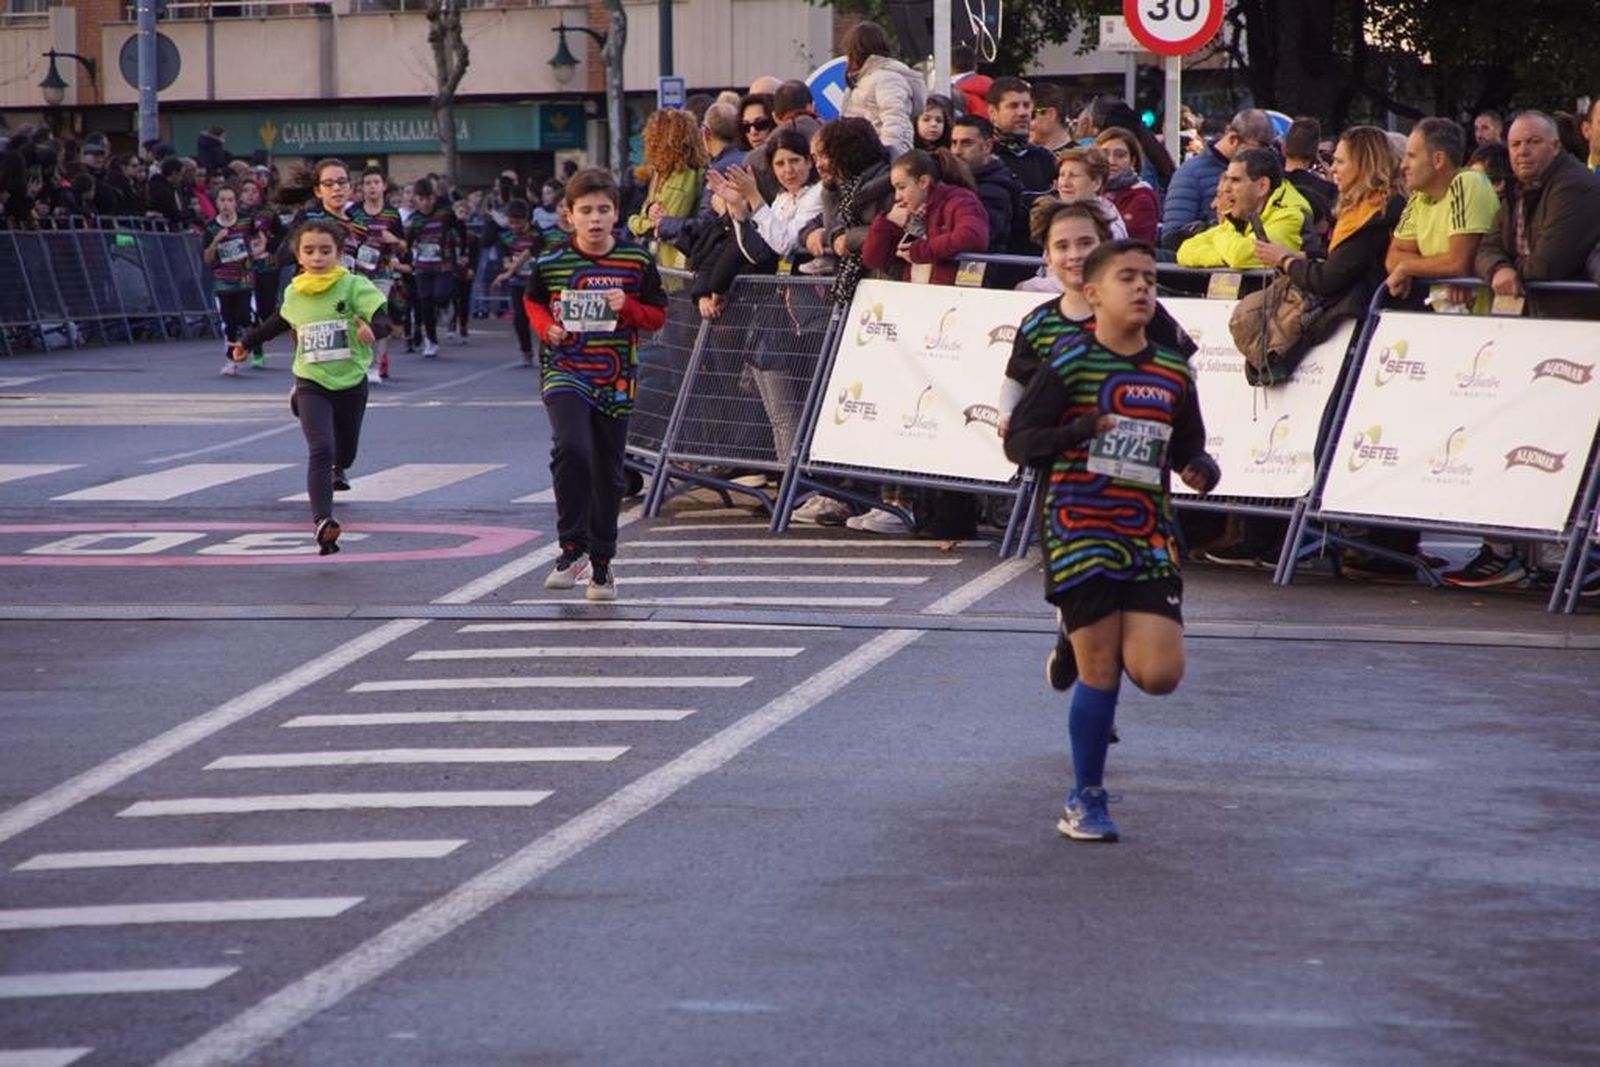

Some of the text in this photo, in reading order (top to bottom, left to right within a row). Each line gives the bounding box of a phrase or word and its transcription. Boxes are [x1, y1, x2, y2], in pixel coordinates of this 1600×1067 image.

[1147, 0, 1200, 21] 30
[282, 116, 469, 148] CAJA RURAL DE SALAMACA
[569, 301, 606, 318] 5747
[303, 329, 335, 351] 5797
[1385, 360, 1427, 375] SETEL
[1102, 432, 1150, 461] 5725
[1358, 445, 1399, 460] SETEL
